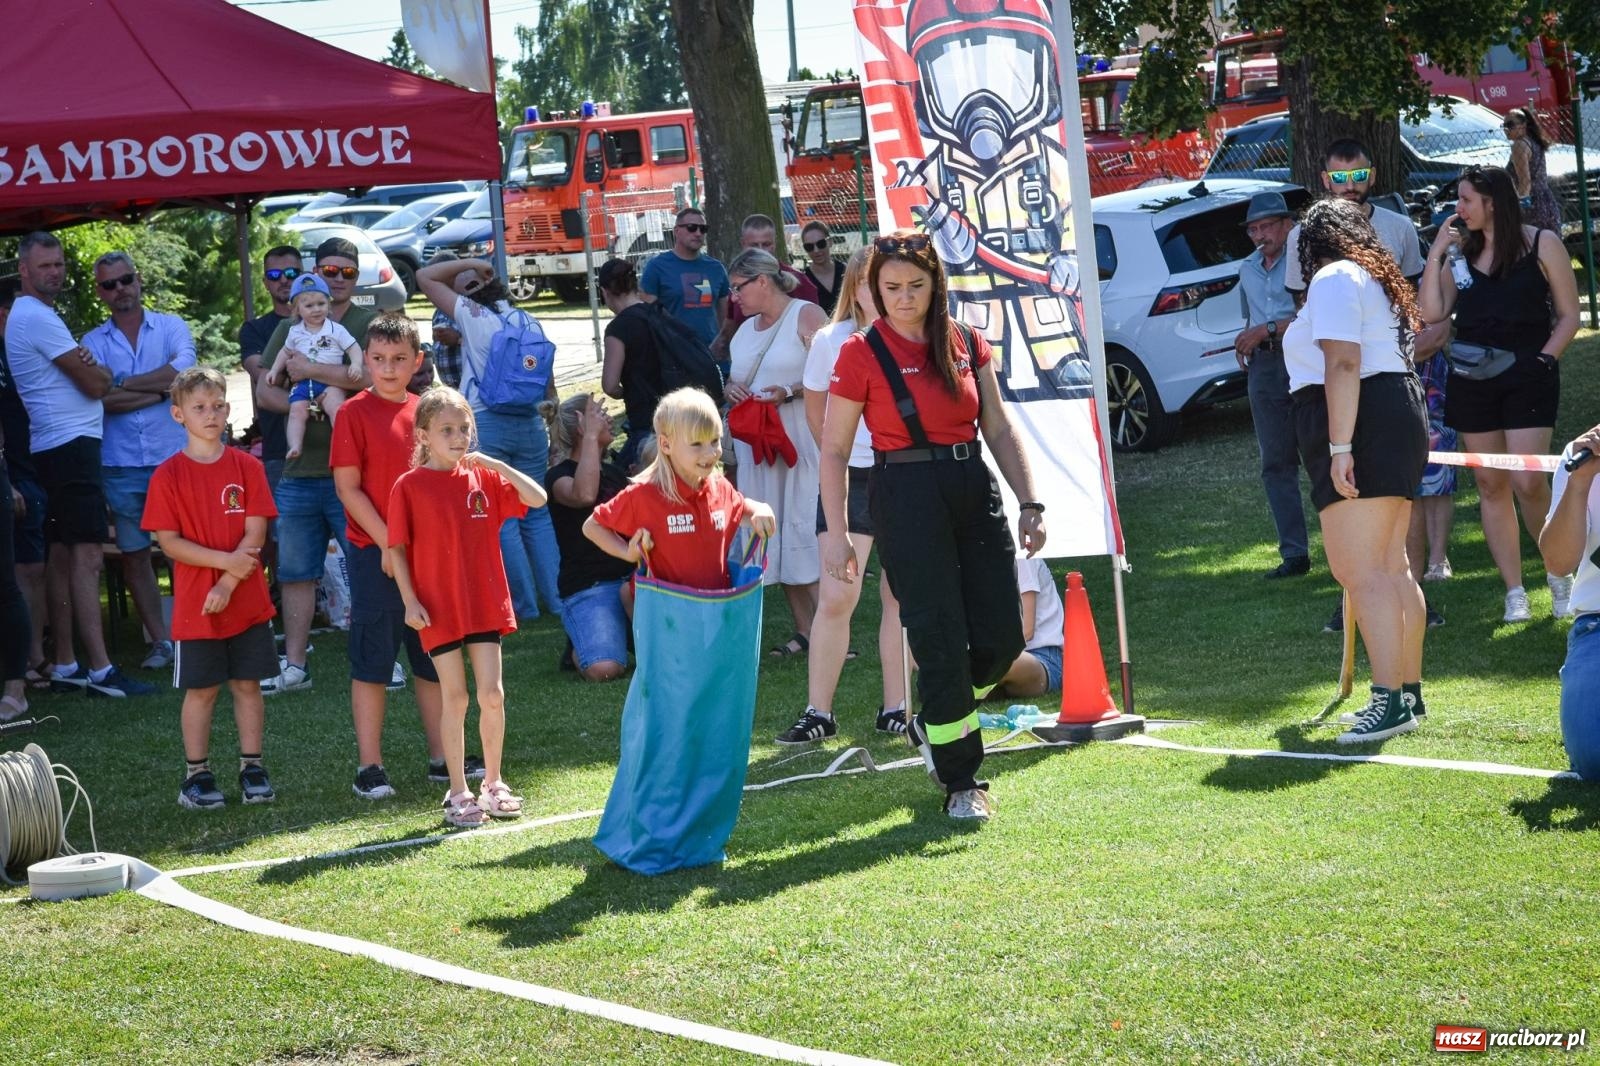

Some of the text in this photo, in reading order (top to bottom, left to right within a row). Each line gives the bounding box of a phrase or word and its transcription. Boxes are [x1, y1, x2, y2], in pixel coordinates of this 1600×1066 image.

[1489, 86, 1507, 98] 998
[0, 125, 412, 187] SAMBOROWICE
[666, 513, 694, 526] OSP
